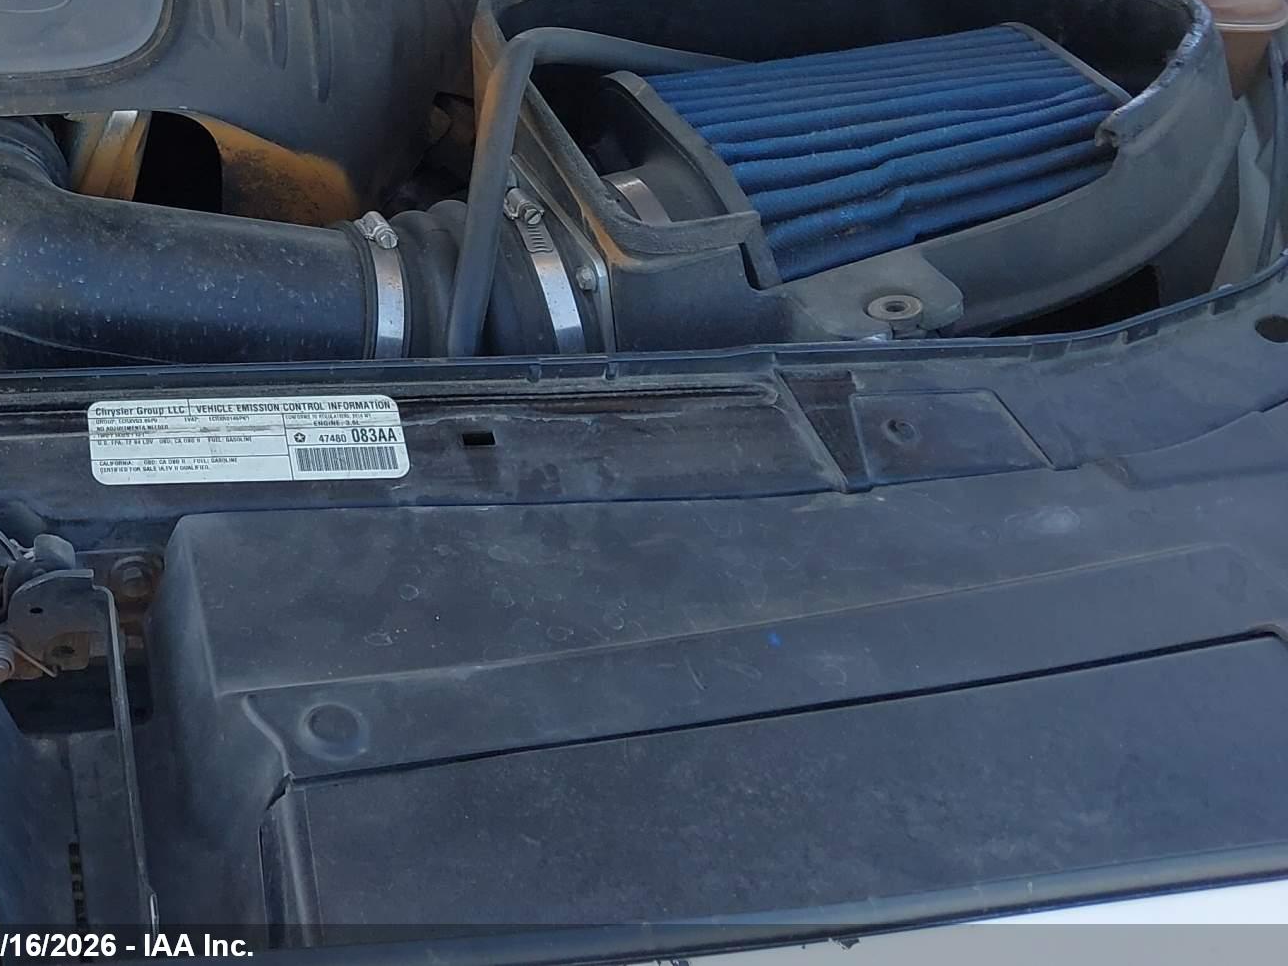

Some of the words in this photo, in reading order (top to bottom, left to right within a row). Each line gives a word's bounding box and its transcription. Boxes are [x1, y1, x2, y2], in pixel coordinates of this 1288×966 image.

[95, 407, 132, 417] Chrysler
[136, 406, 165, 417] Group
[168, 405, 185, 415] LLC
[196, 404, 233, 413] VEHICLE
[236, 403, 280, 413] EMISSION
[283, 402, 325, 412] CONTROL
[328, 400, 391, 410] INFORMATION
[319, 434, 347, 443] 47480
[352, 428, 398, 443] 083AA
